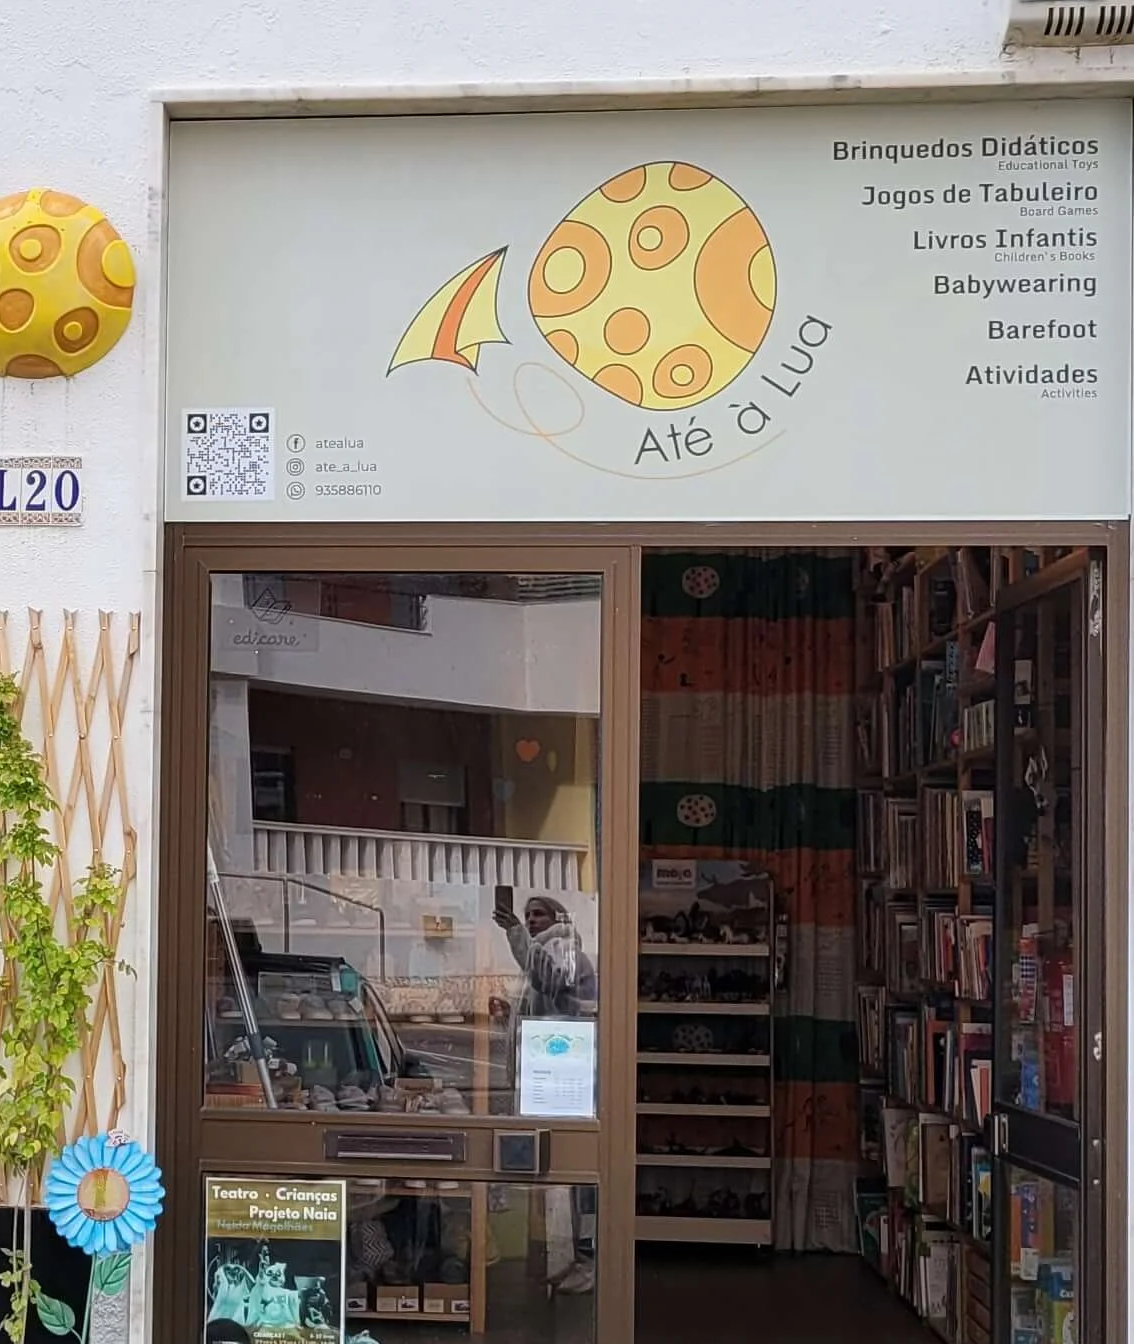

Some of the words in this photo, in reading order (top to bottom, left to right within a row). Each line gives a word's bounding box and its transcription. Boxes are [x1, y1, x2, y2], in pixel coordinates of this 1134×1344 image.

[833, 138, 972, 164] Brinquedos
[981, 135, 1099, 156] Didáticos
[998, 160, 1068, 171] Educational
[1072, 159, 1099, 171] Toys
[861, 186, 934, 209] Jogos
[943, 184, 971, 203] de
[979, 182, 1098, 202] Tabuleiro
[1019, 206, 1054, 217] Board
[1058, 206, 1099, 216] Games
[913, 231, 987, 249] Livros
[995, 228, 1097, 248] Infantis
[1059, 252, 1095, 262] Books
[934, 273, 1097, 299] Babywearing
[988, 319, 1097, 339] Barefoot
[965, 364, 1098, 384] Atividades
[634, 416, 713, 465] Até
[728, 401, 771, 434] à
[761, 315, 833, 397] Lua
[1040, 388, 1098, 399] Activities
[315, 437, 364, 449] atealua
[315, 460, 377, 473] ate_a_lua
[315, 484, 382, 496] 935886110
[212, 1186, 259, 1200] Teatro
[275, 1187, 338, 1205] Crianças
[249, 1205, 300, 1222] Projeto
[303, 1207, 338, 1221] Naia
